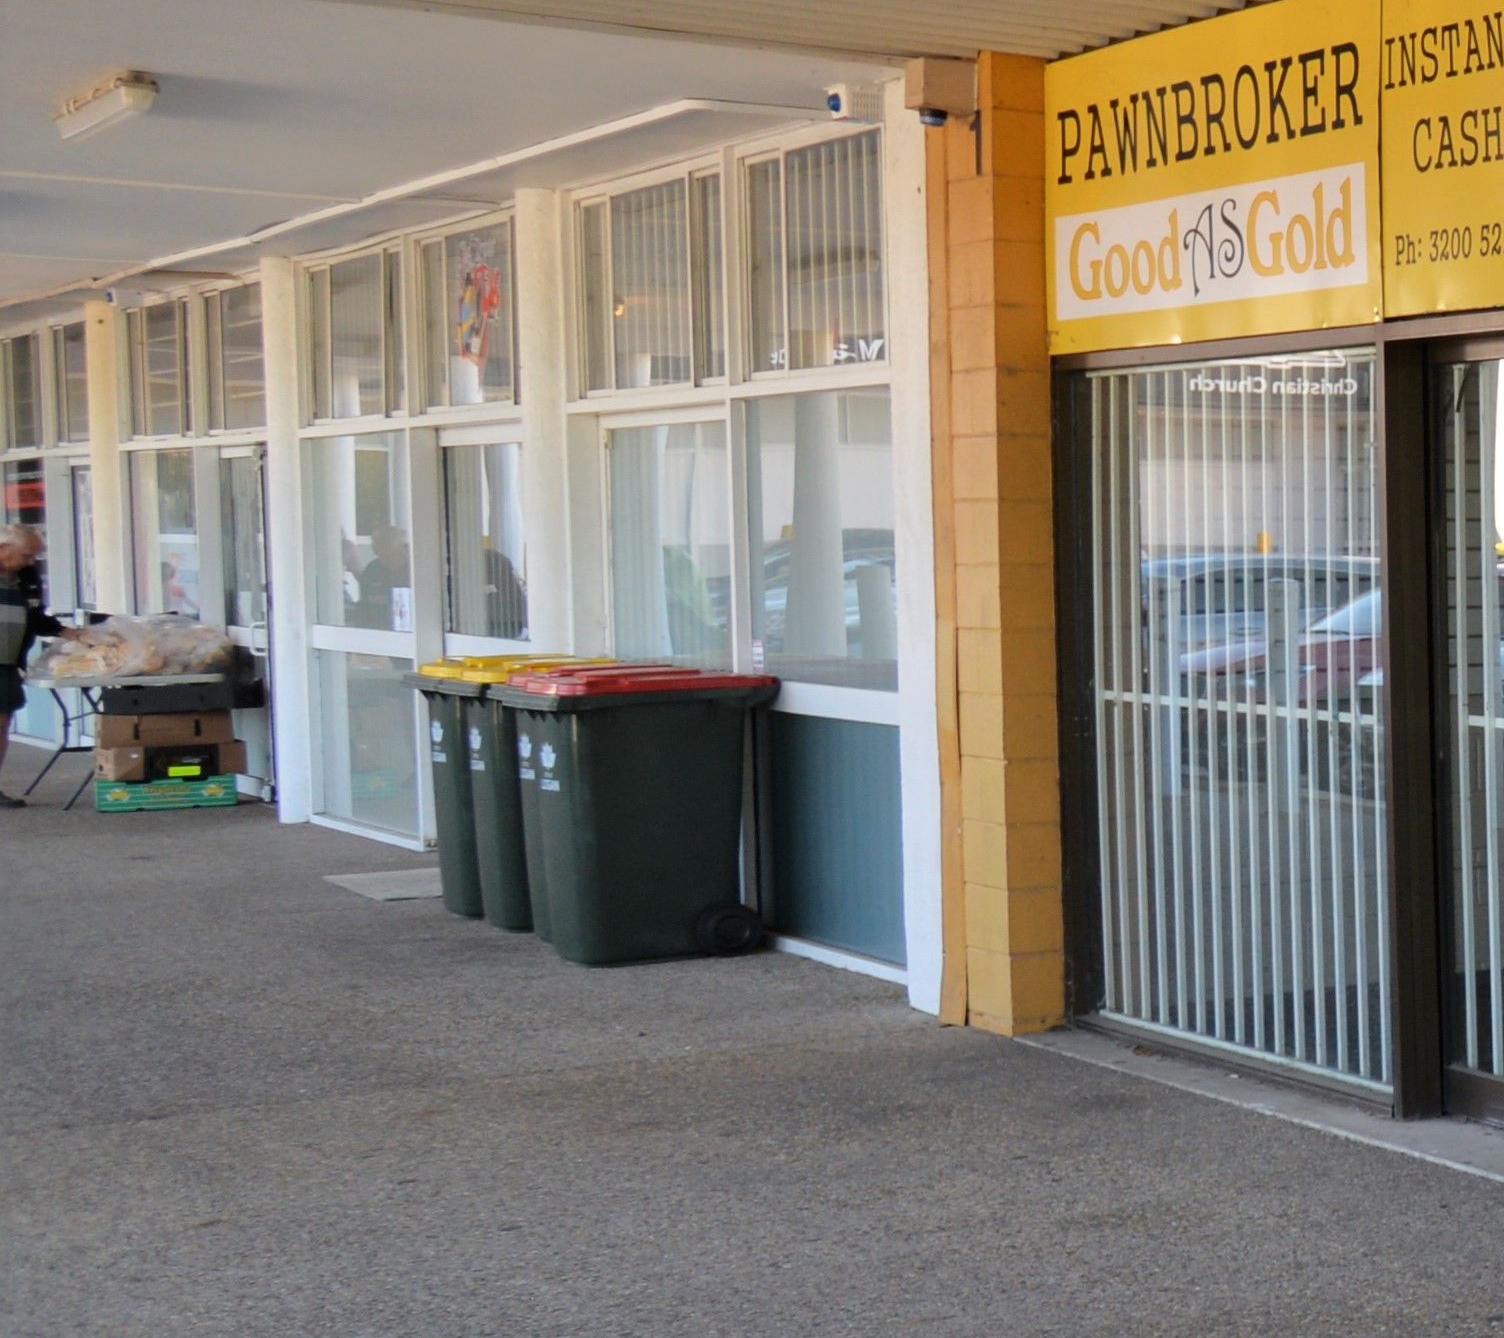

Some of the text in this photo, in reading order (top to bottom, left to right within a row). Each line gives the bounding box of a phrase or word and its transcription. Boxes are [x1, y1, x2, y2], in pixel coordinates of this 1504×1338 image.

[1057, 41, 1363, 185] PAWNBROKER
[1412, 106, 1504, 173] CASH
[1069, 176, 1355, 301] Good AS Gold
[1395, 233, 1422, 266] Ph:
[1429, 225, 1473, 263] 3200
